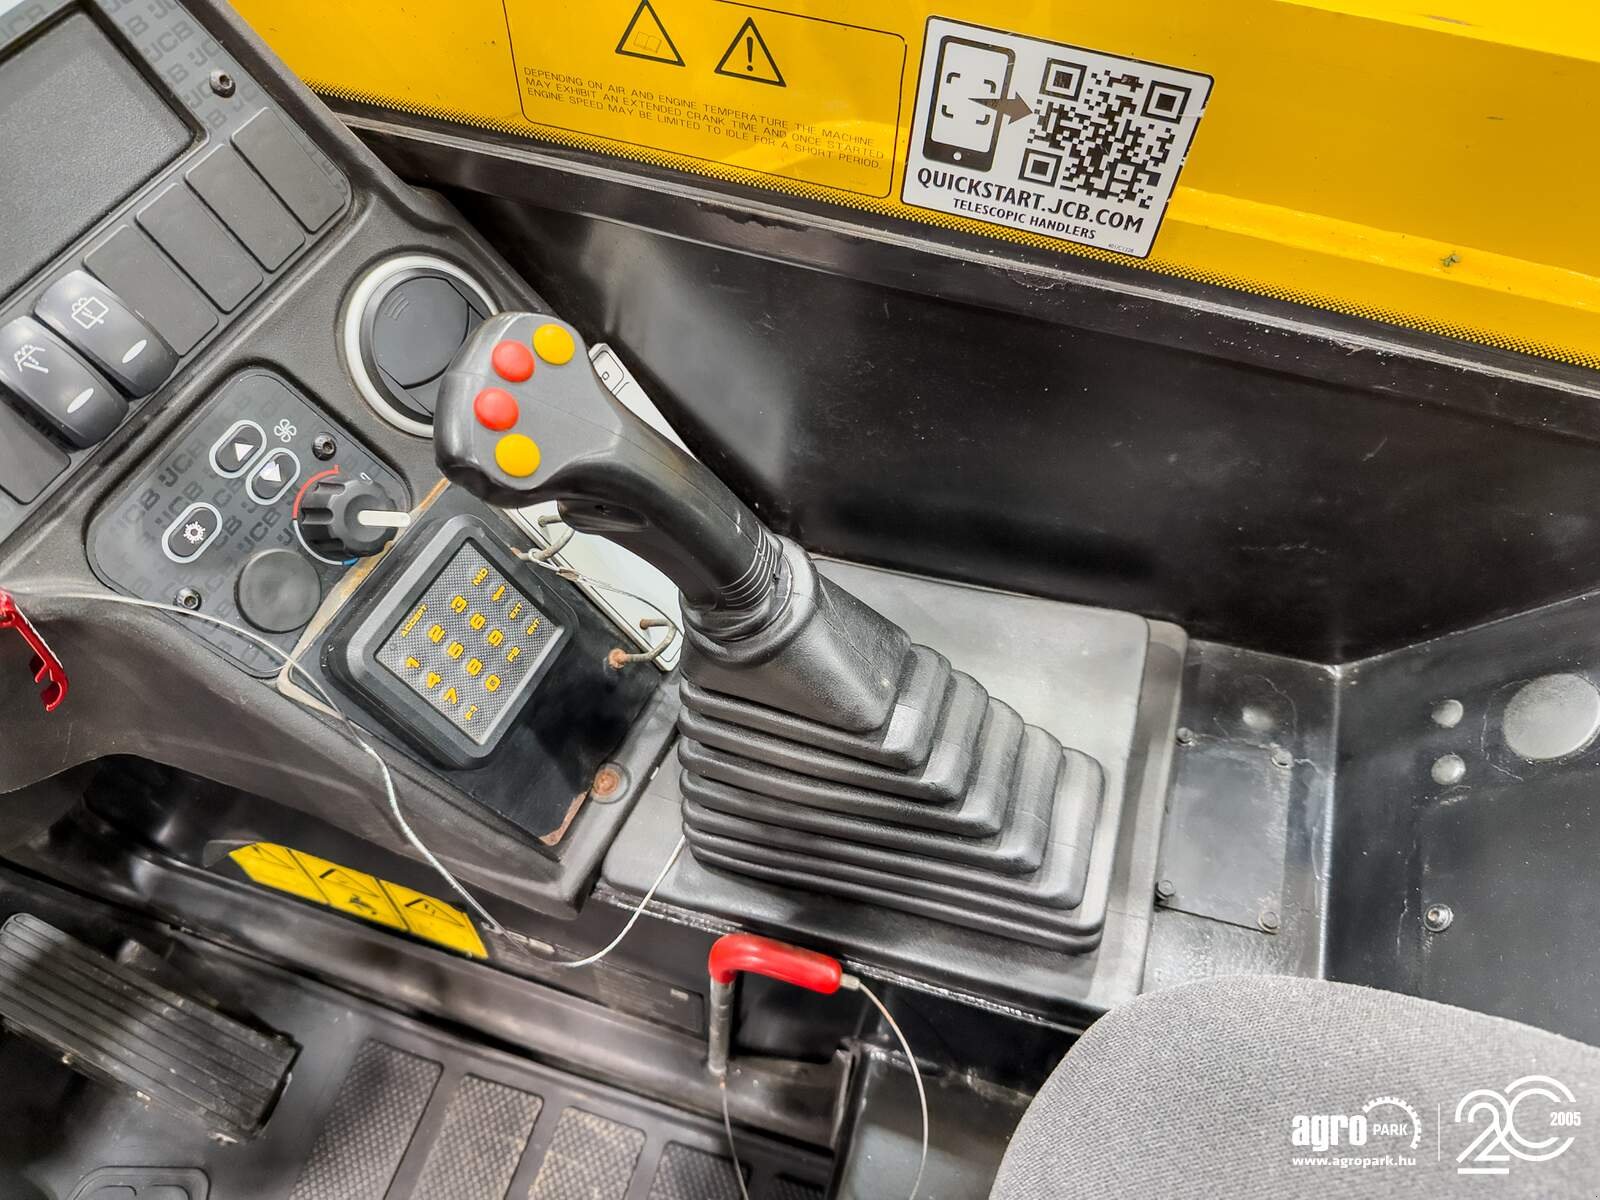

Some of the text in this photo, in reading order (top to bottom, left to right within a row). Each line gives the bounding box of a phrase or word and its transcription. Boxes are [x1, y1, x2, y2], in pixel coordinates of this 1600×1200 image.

[141, 20, 195, 62] JCB
[187, 38, 221, 67] JC
[182, 78, 212, 109] JC
[524, 67, 874, 147] DEPENDING ON AIR AND ENGINE TEMPERATURE THE MACHINE
[526, 77, 884, 160] MAY EXHIBIT AN EXTENDED CRANK TIME AND ONCE STARTED
[527, 87, 882, 170] ENGINE SPEED MAY BE LIMITED TO IDLE FOR A SHORT PERIOD.
[917, 167, 1144, 234] QUICKSTART.JCB.COM
[953, 198, 1097, 240] TELESCOPIC HANDLERS
[158, 439, 206, 487] JCB
[212, 478, 244, 508] CB
[236, 507, 281, 554] JCB
[402, 604, 428, 637] ACCEPT
[405, 656, 421, 669] 1
[427, 624, 446, 644] 2
[451, 595, 469, 614] 3
[426, 613, 487, 689] 4 5 6
[443, 602, 522, 705] 7 8 9 EXT
[465, 704, 478, 721] F1
[506, 646, 521, 663] F2
[526, 618, 541, 636] ENT
